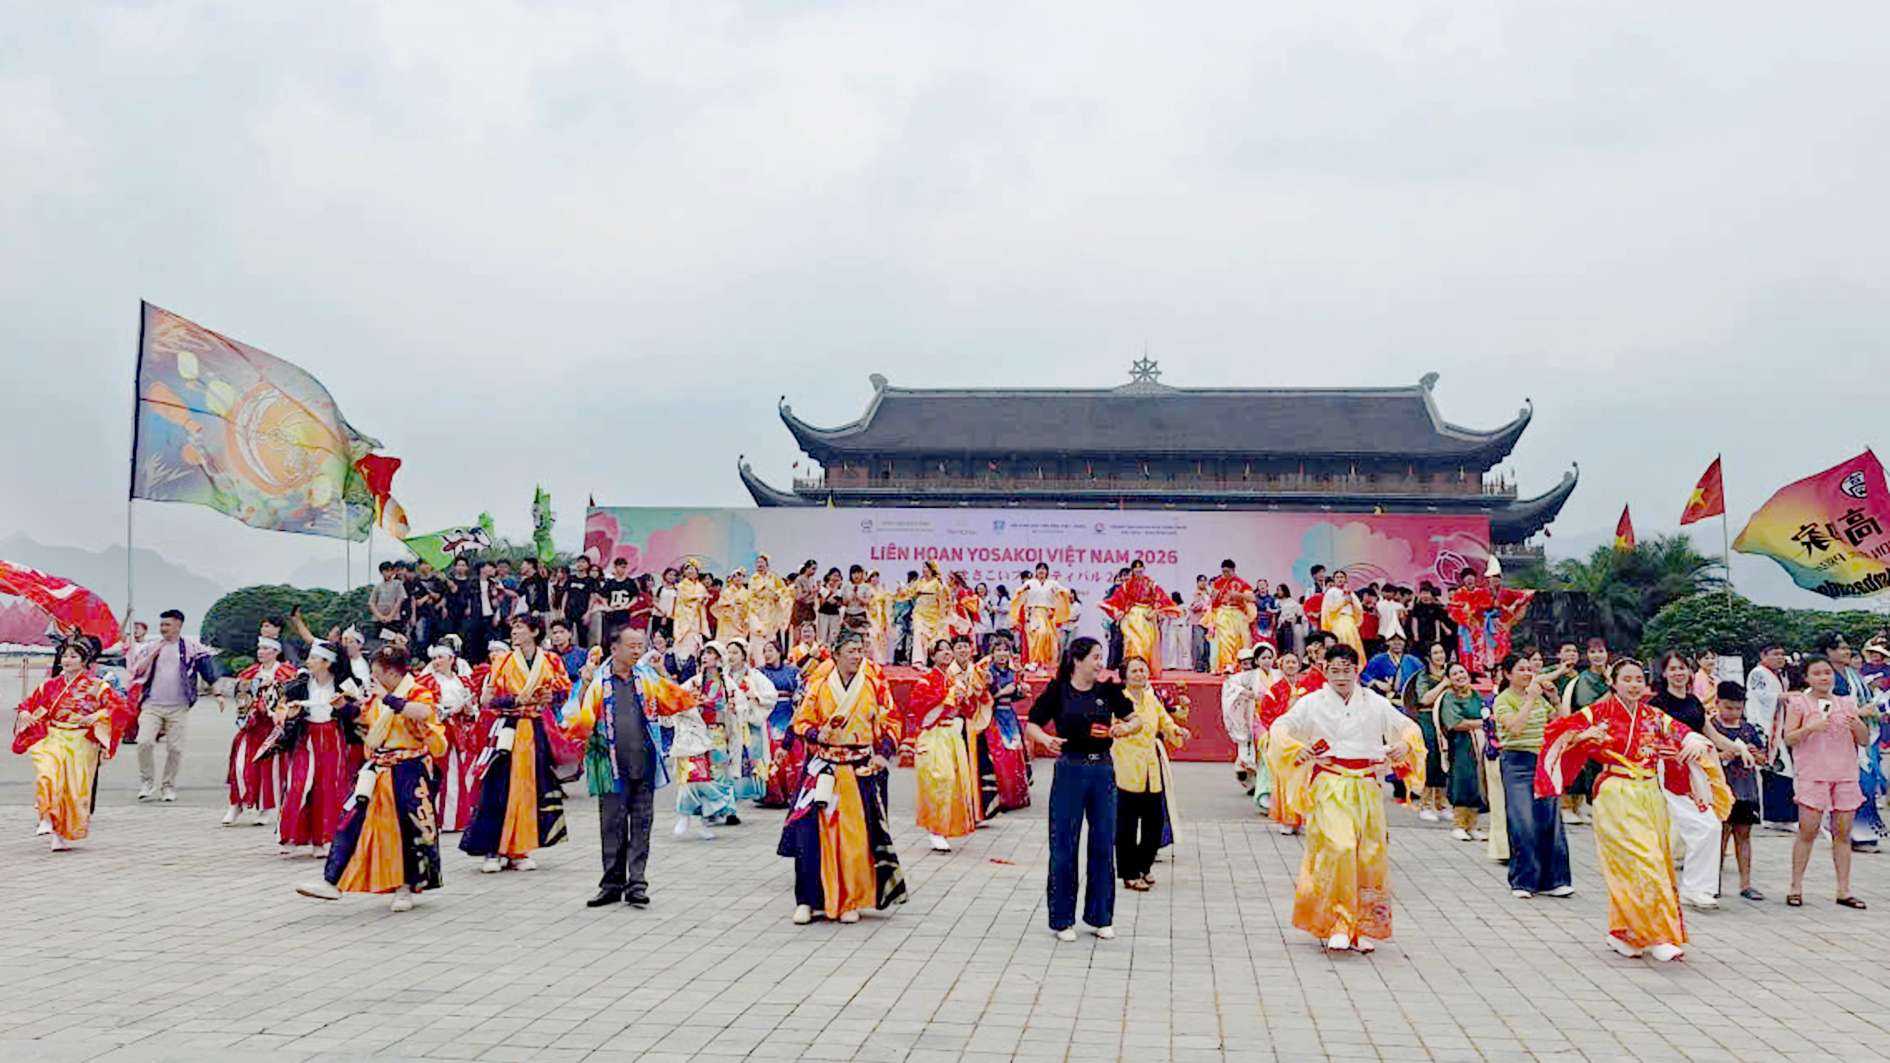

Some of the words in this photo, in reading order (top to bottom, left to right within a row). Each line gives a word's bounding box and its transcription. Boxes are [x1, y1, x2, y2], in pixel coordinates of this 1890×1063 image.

[870, 542, 909, 561] LIÊN
[914, 546, 963, 562] HOAN
[967, 547, 1043, 562] YOSAKOI
[1047, 543, 1086, 567] VIỆT
[1090, 549, 1129, 563] NAM
[1135, 550, 1178, 564] 2026
